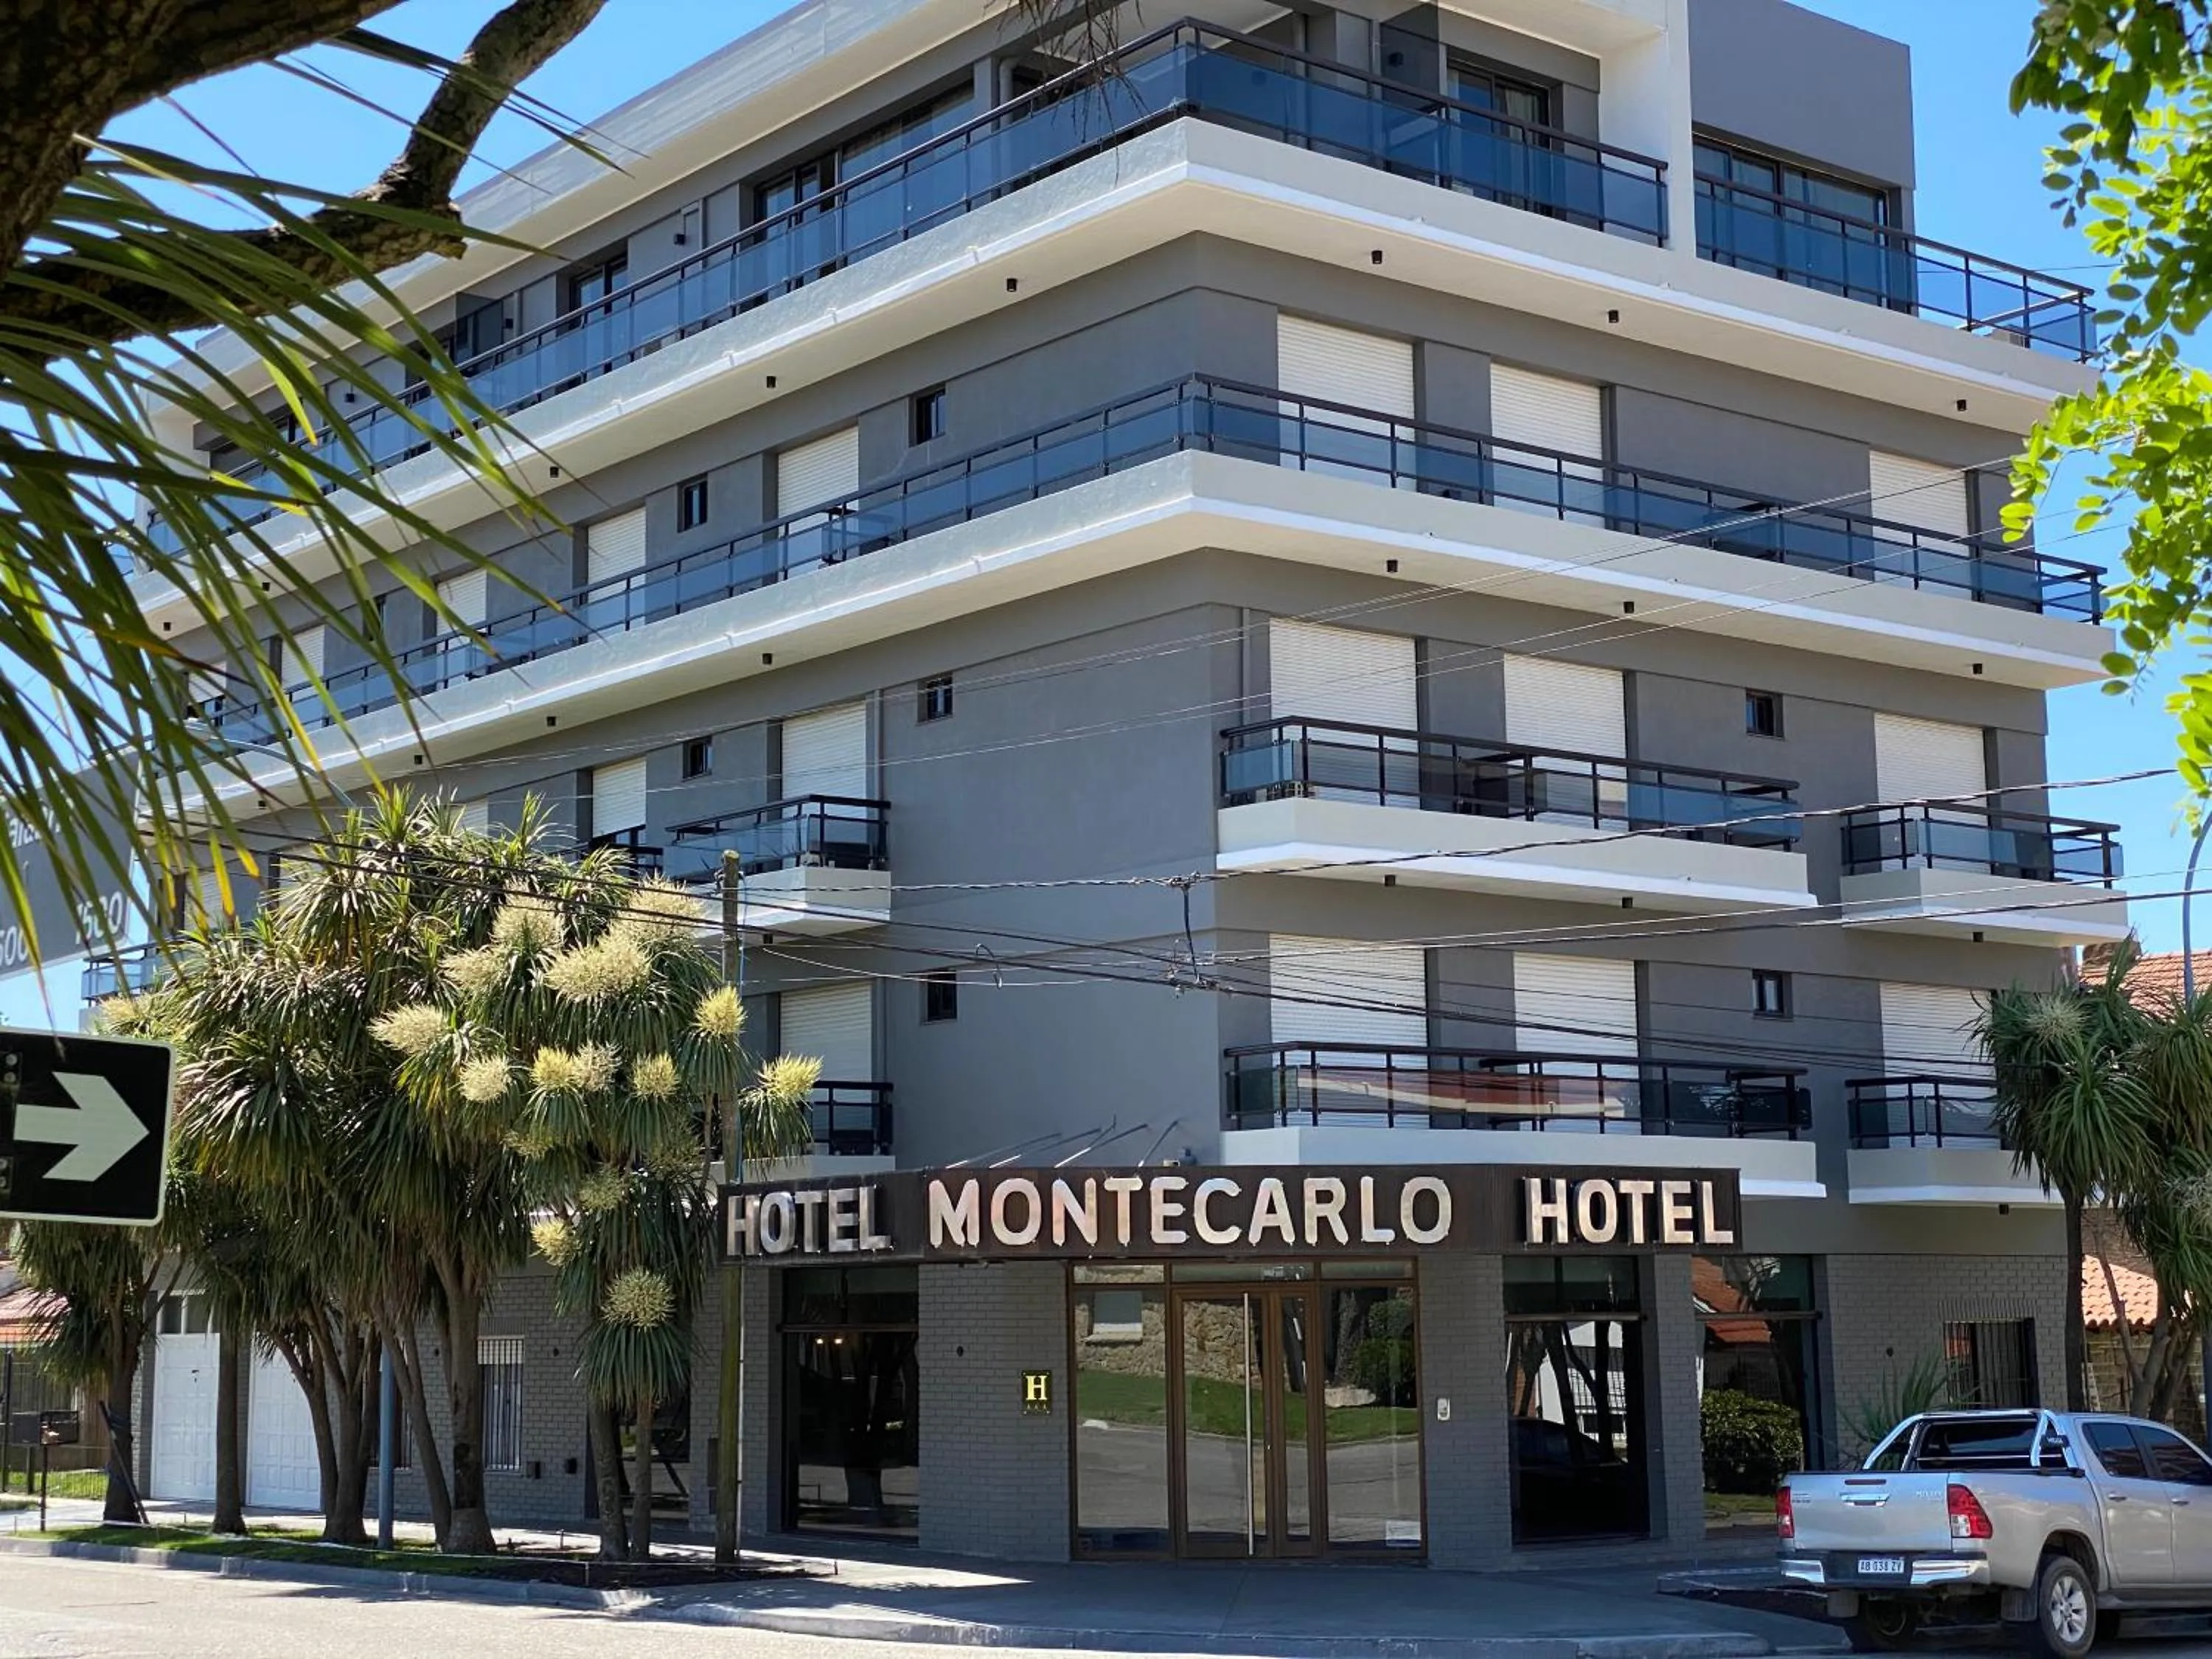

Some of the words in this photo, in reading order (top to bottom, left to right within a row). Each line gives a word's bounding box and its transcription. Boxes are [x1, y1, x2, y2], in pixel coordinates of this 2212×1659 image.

[726, 1186, 889, 1255] HOTEL
[928, 1176, 1452, 1247] MONTECARLO
[1523, 1177, 1735, 1245] HOTEL
[1026, 1375, 1048, 1400] H
